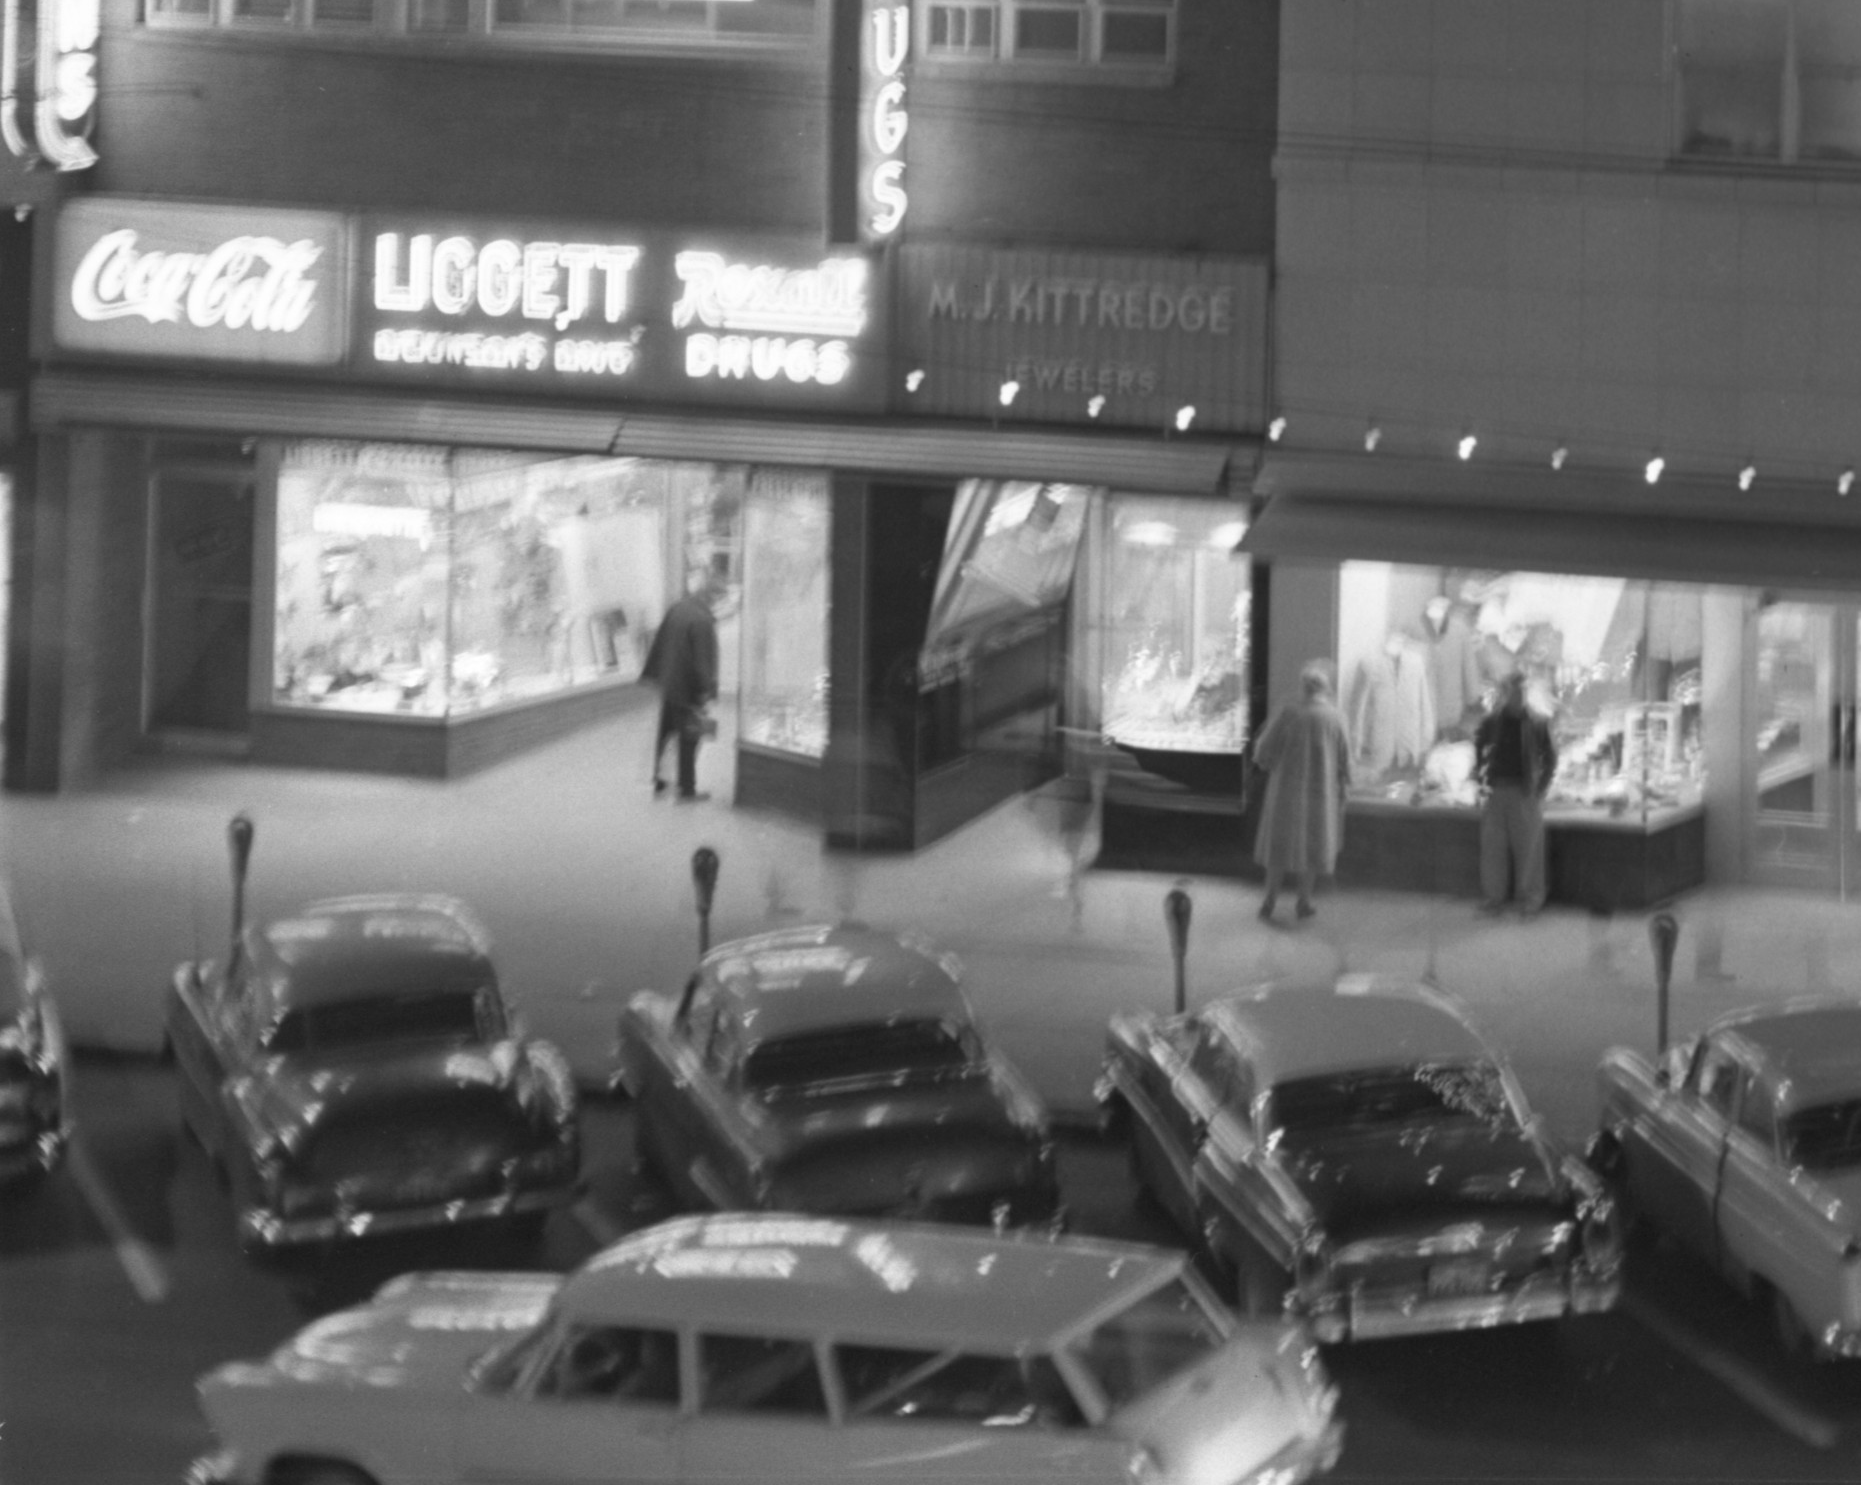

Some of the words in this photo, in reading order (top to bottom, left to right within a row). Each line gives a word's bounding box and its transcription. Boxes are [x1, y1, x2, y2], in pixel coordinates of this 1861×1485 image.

[71, 228, 325, 333] Coca-Cola
[374, 232, 641, 323] LIGGETT
[672, 249, 868, 335] Rexall
[1009, 281, 1231, 333] KITTREDGE
[684, 332, 852, 385] DRUGS
